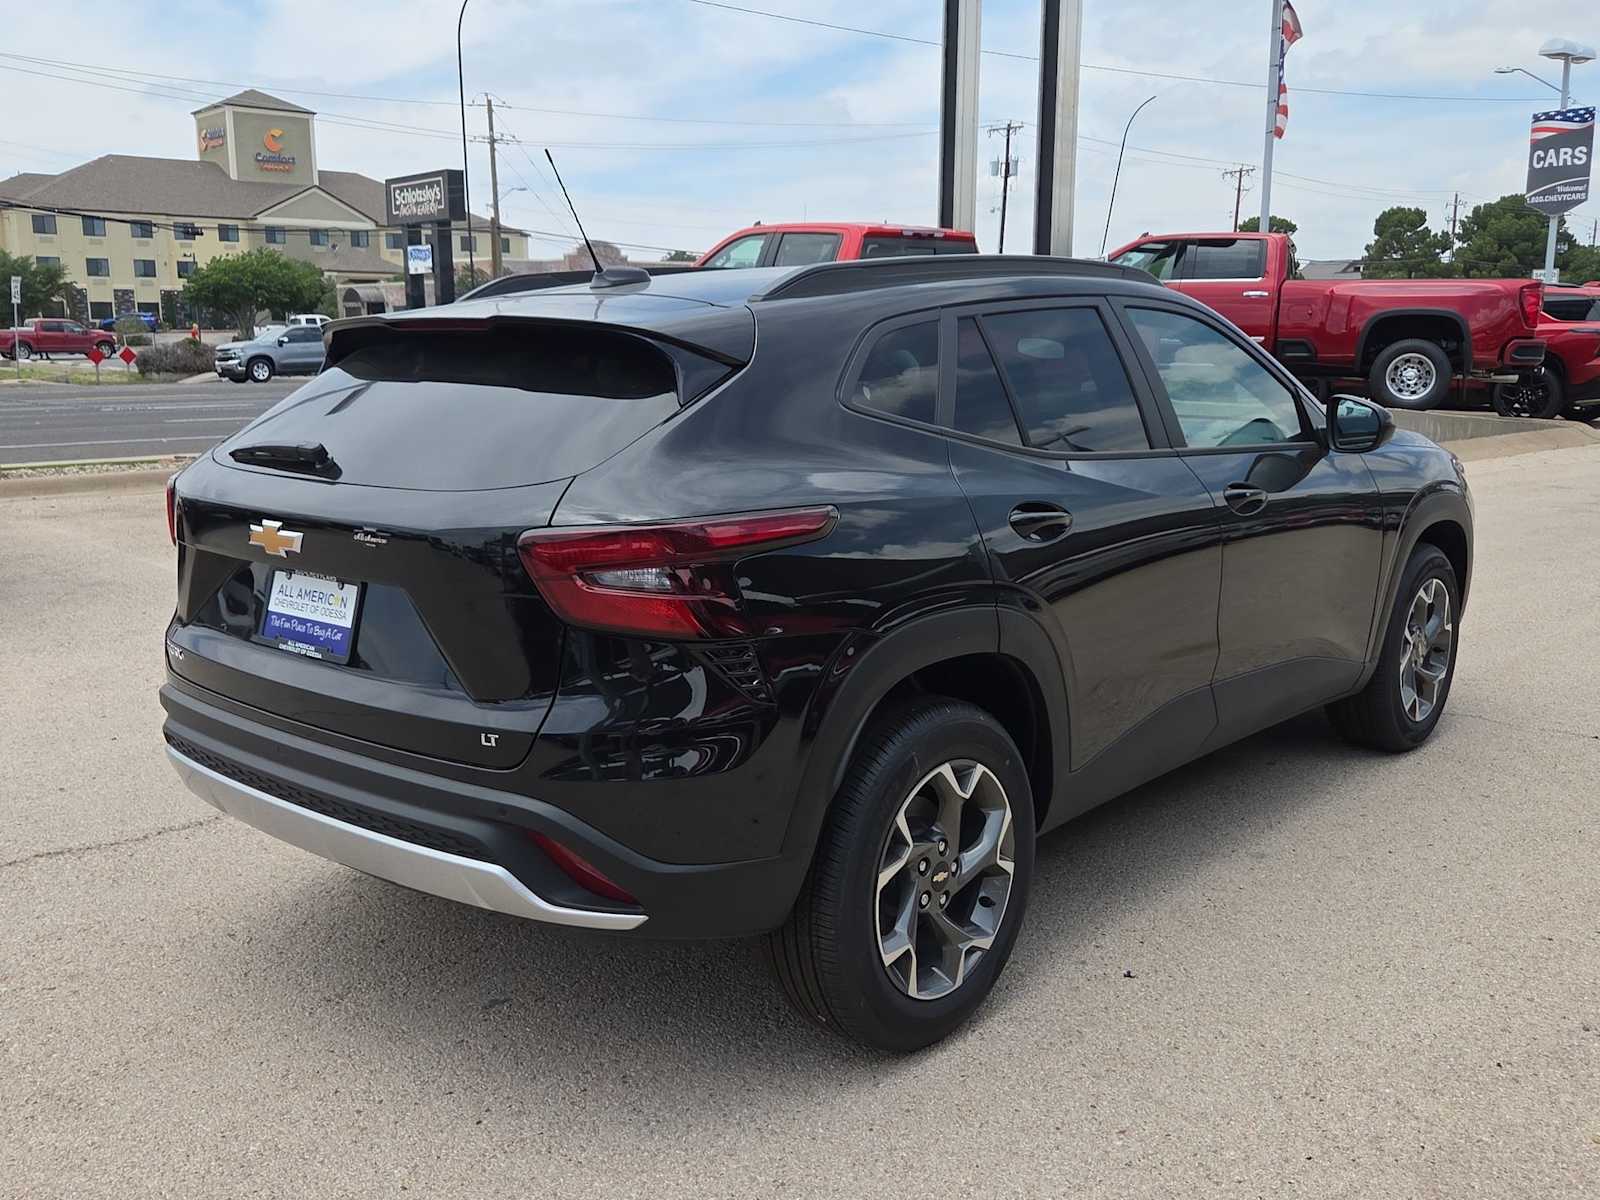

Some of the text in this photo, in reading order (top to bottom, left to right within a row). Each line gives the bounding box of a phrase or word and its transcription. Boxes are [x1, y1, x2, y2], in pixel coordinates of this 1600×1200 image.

[1532, 146, 1588, 169] CARS
[395, 184, 441, 206] Schlotzsky's
[278, 584, 294, 598] ALL
[274, 598, 347, 620] CHEVROLET OF ODESSA
[271, 615, 280, 628] The
[291, 619, 306, 633] Place
[306, 622, 314, 634] To
[313, 625, 325, 641] Buy
[324, 627, 332, 639] A
[331, 629, 343, 641] Car
[480, 733, 499, 747] LT
